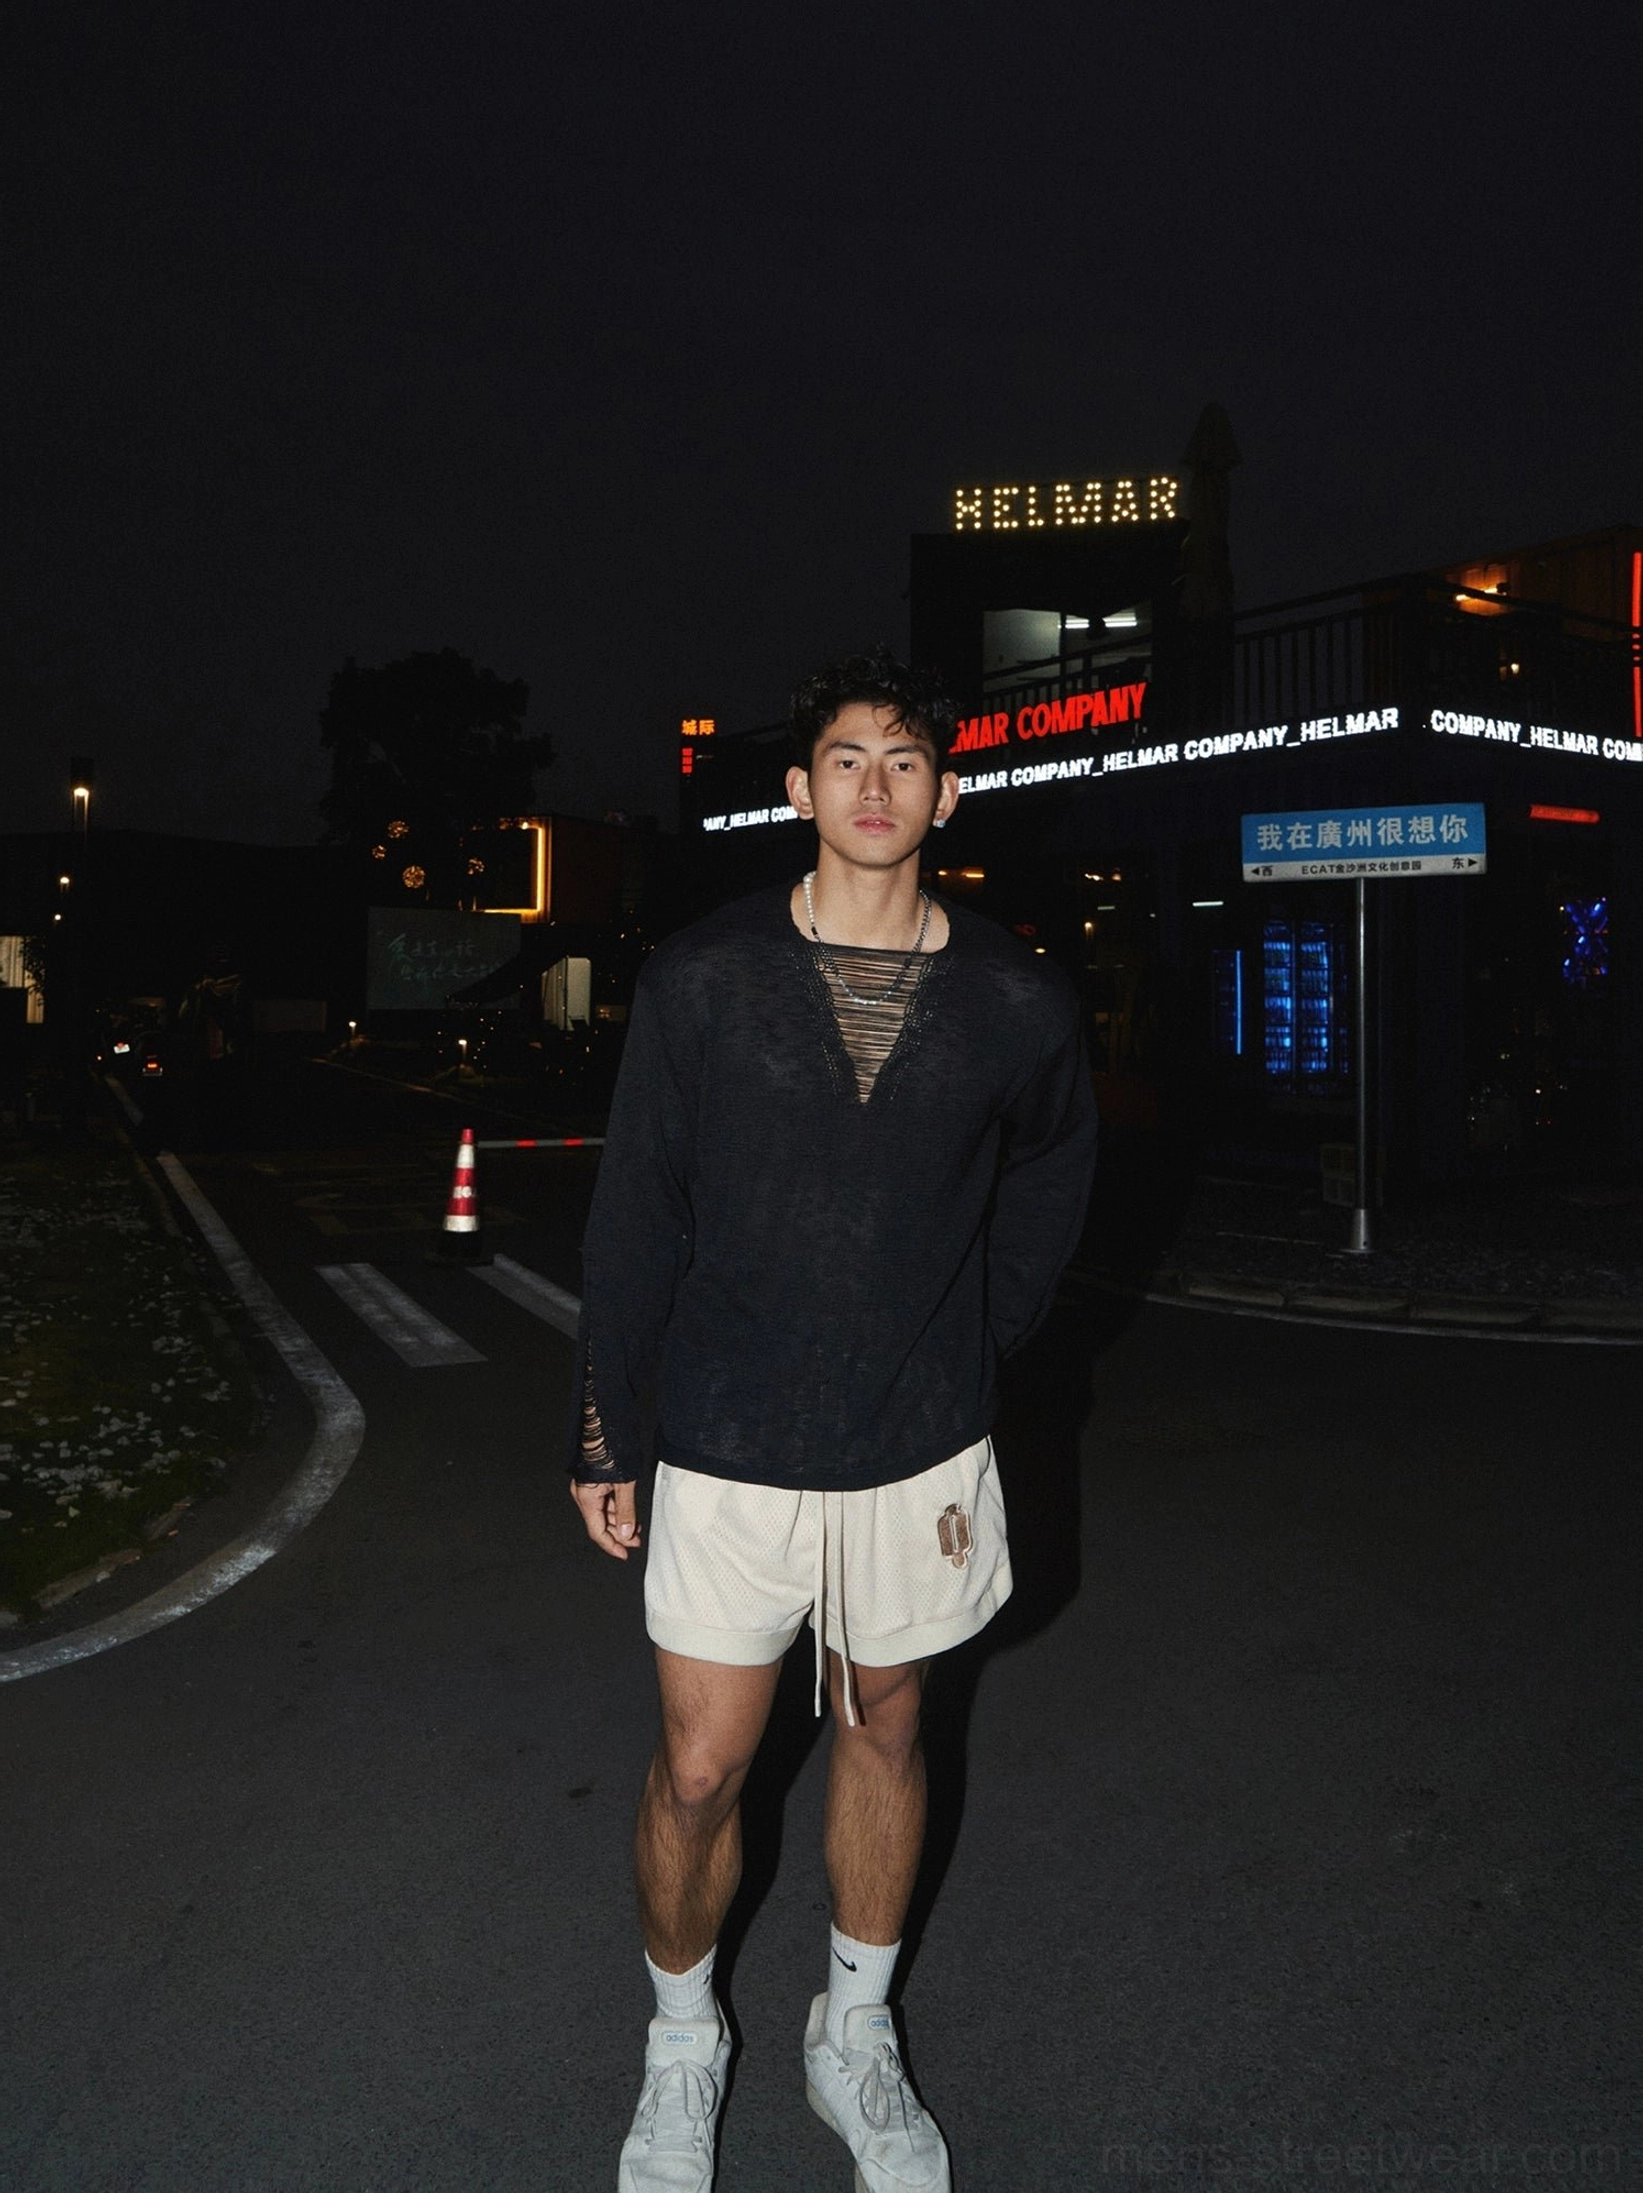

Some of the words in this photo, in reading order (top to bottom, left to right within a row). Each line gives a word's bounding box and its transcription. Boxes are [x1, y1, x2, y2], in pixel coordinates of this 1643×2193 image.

[955, 476, 1178, 531] HELMAR
[1016, 682, 1147, 740] COMPANY
[1430, 709, 1600, 756] COMPANY_HELMAR
[1010, 743, 1179, 787] COMPANY_HELMAR
[1183, 707, 1399, 760] COMPANY_HELMAR
[1257, 814, 1469, 851] 我在廣州很想你
[1261, 865, 1274, 877] 西
[1452, 857, 1465, 870] 东
[666, 2033, 694, 2043] adidas
